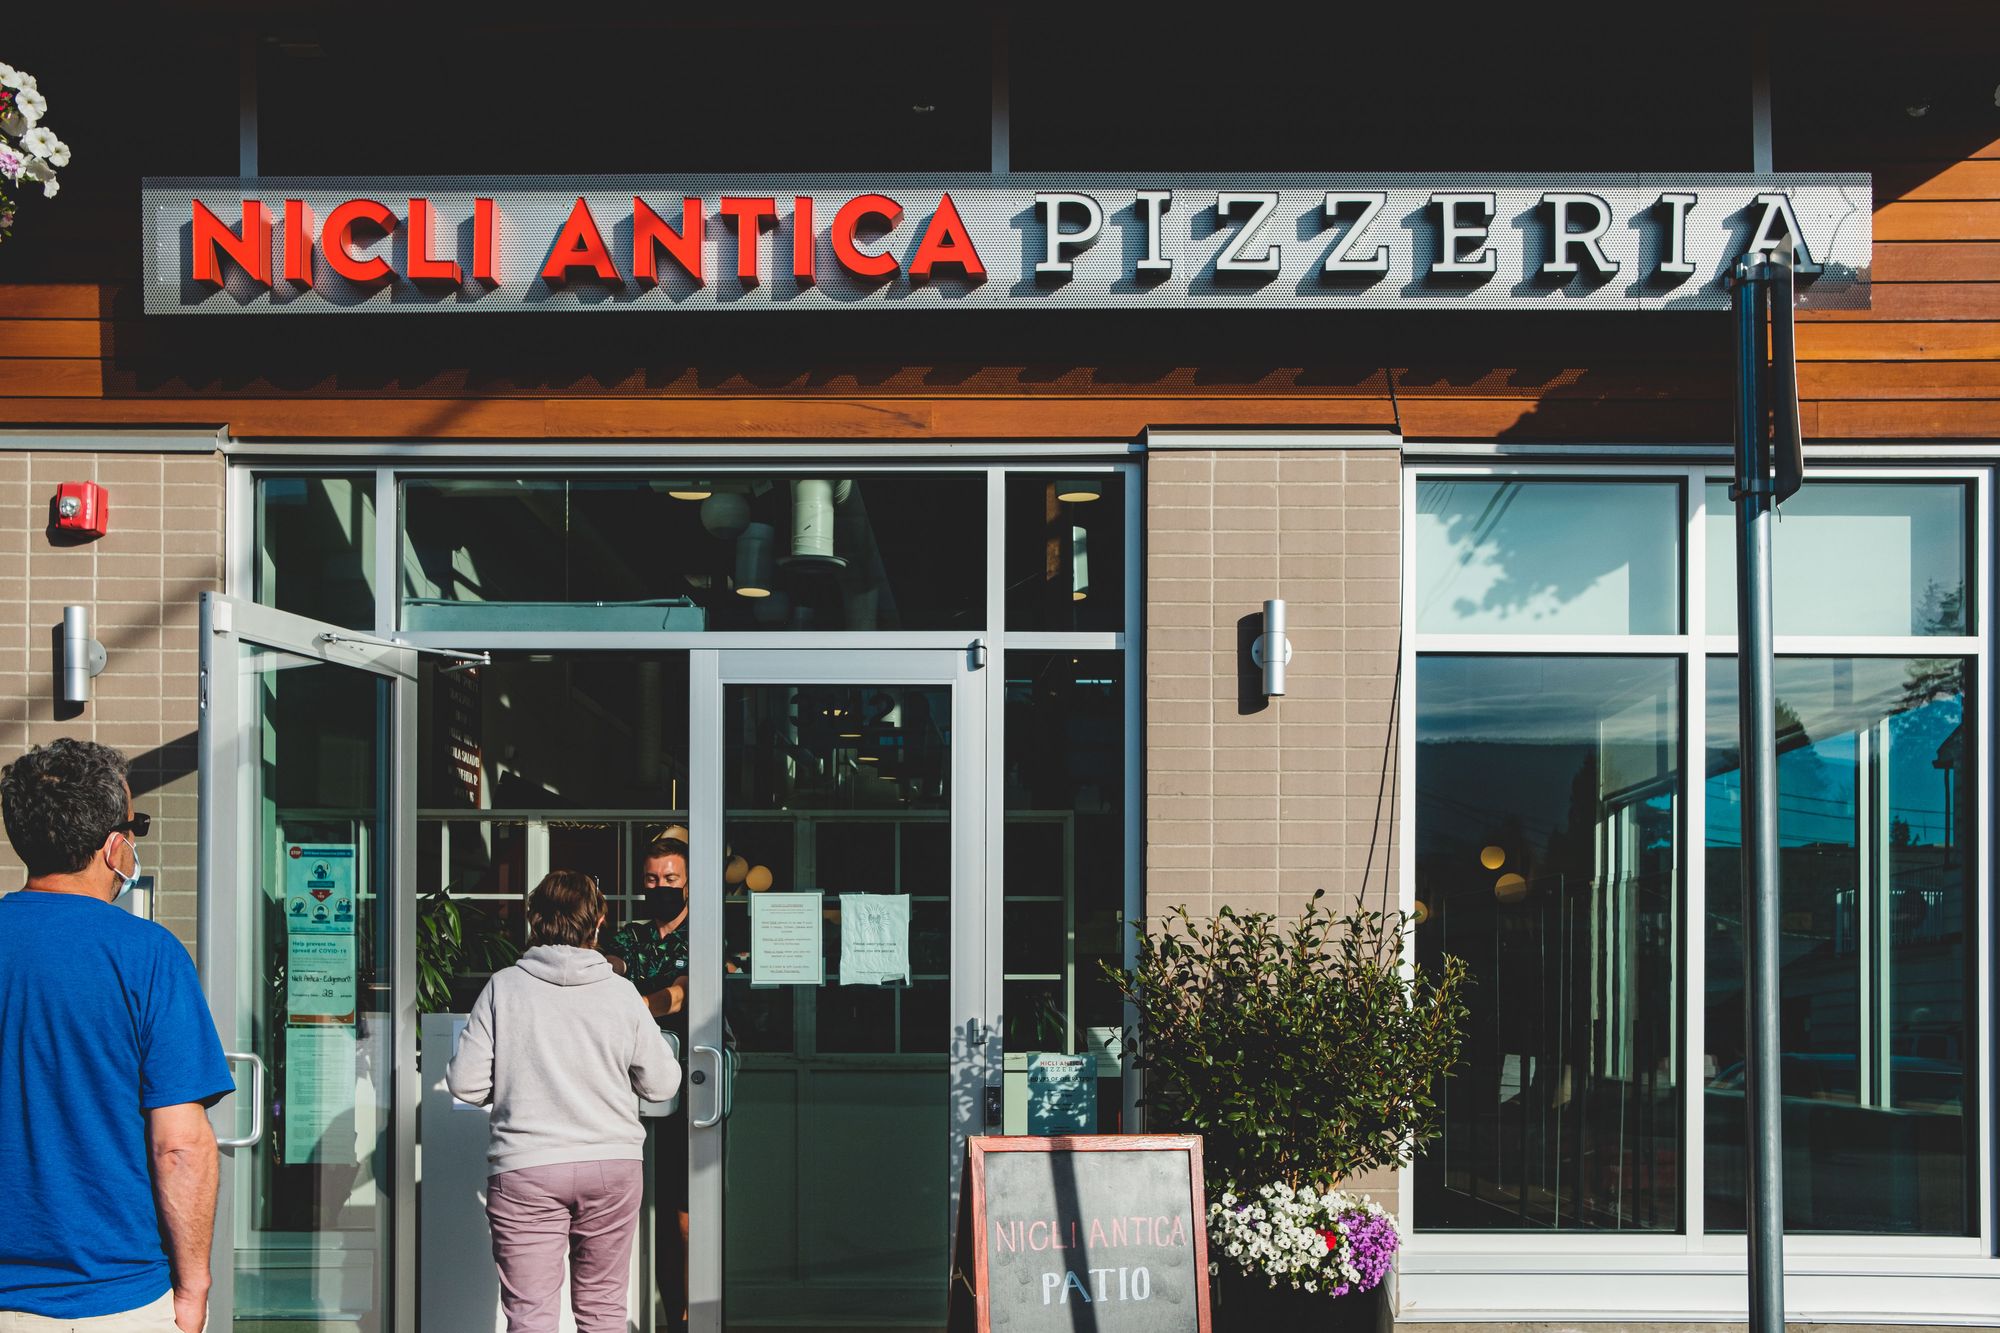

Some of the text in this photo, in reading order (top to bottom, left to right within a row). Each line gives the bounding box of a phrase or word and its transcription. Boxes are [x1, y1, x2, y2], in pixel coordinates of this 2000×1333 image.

[193, 191, 1824, 291] NICLI ANTICA PIZZERIA
[996, 1215, 1187, 1253] NICLI ANTICA
[1042, 1267, 1151, 1305] PATIO
